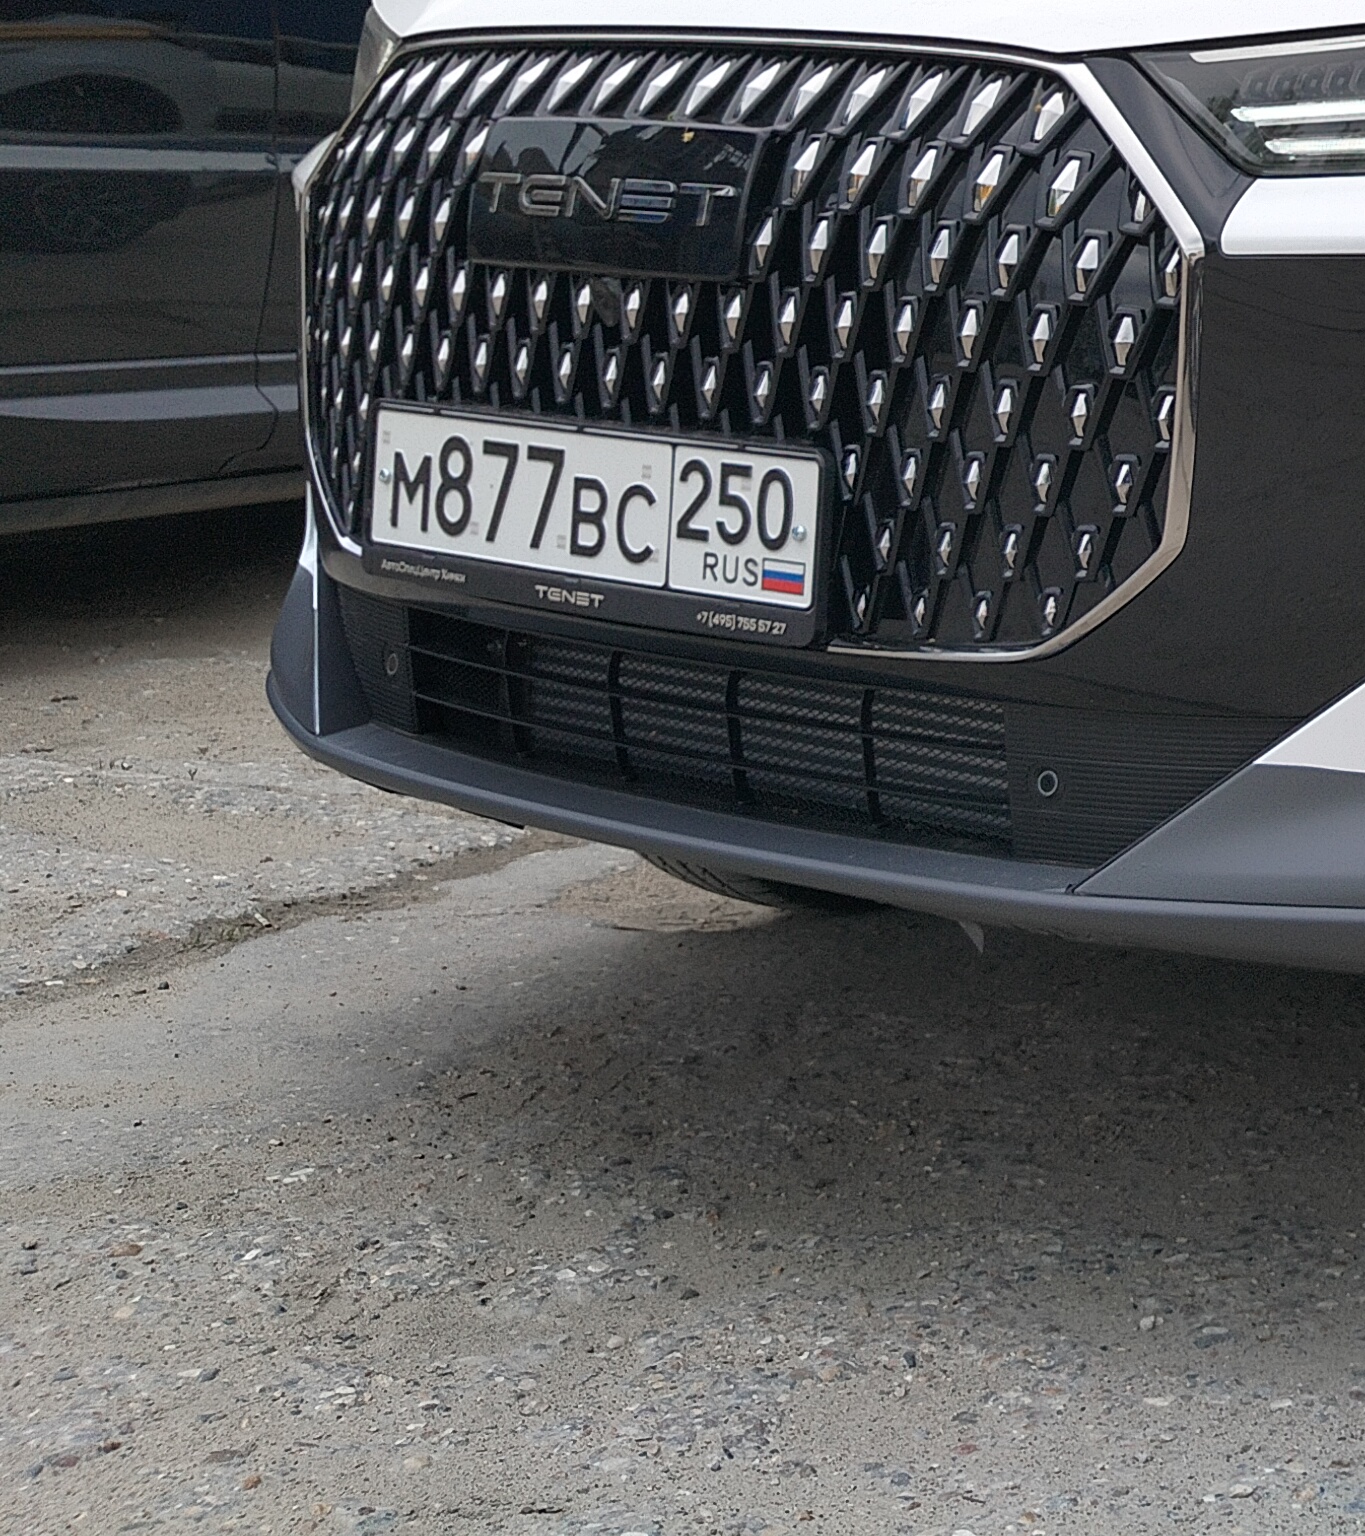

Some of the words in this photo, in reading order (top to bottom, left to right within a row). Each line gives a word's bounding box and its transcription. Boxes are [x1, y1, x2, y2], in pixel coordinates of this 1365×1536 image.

[479, 172, 738, 227] TENET
[676, 458, 795, 552] 250
[702, 552, 759, 588] RUS
[534, 584, 605, 609] TENET
[772, 622, 787, 635] 27
